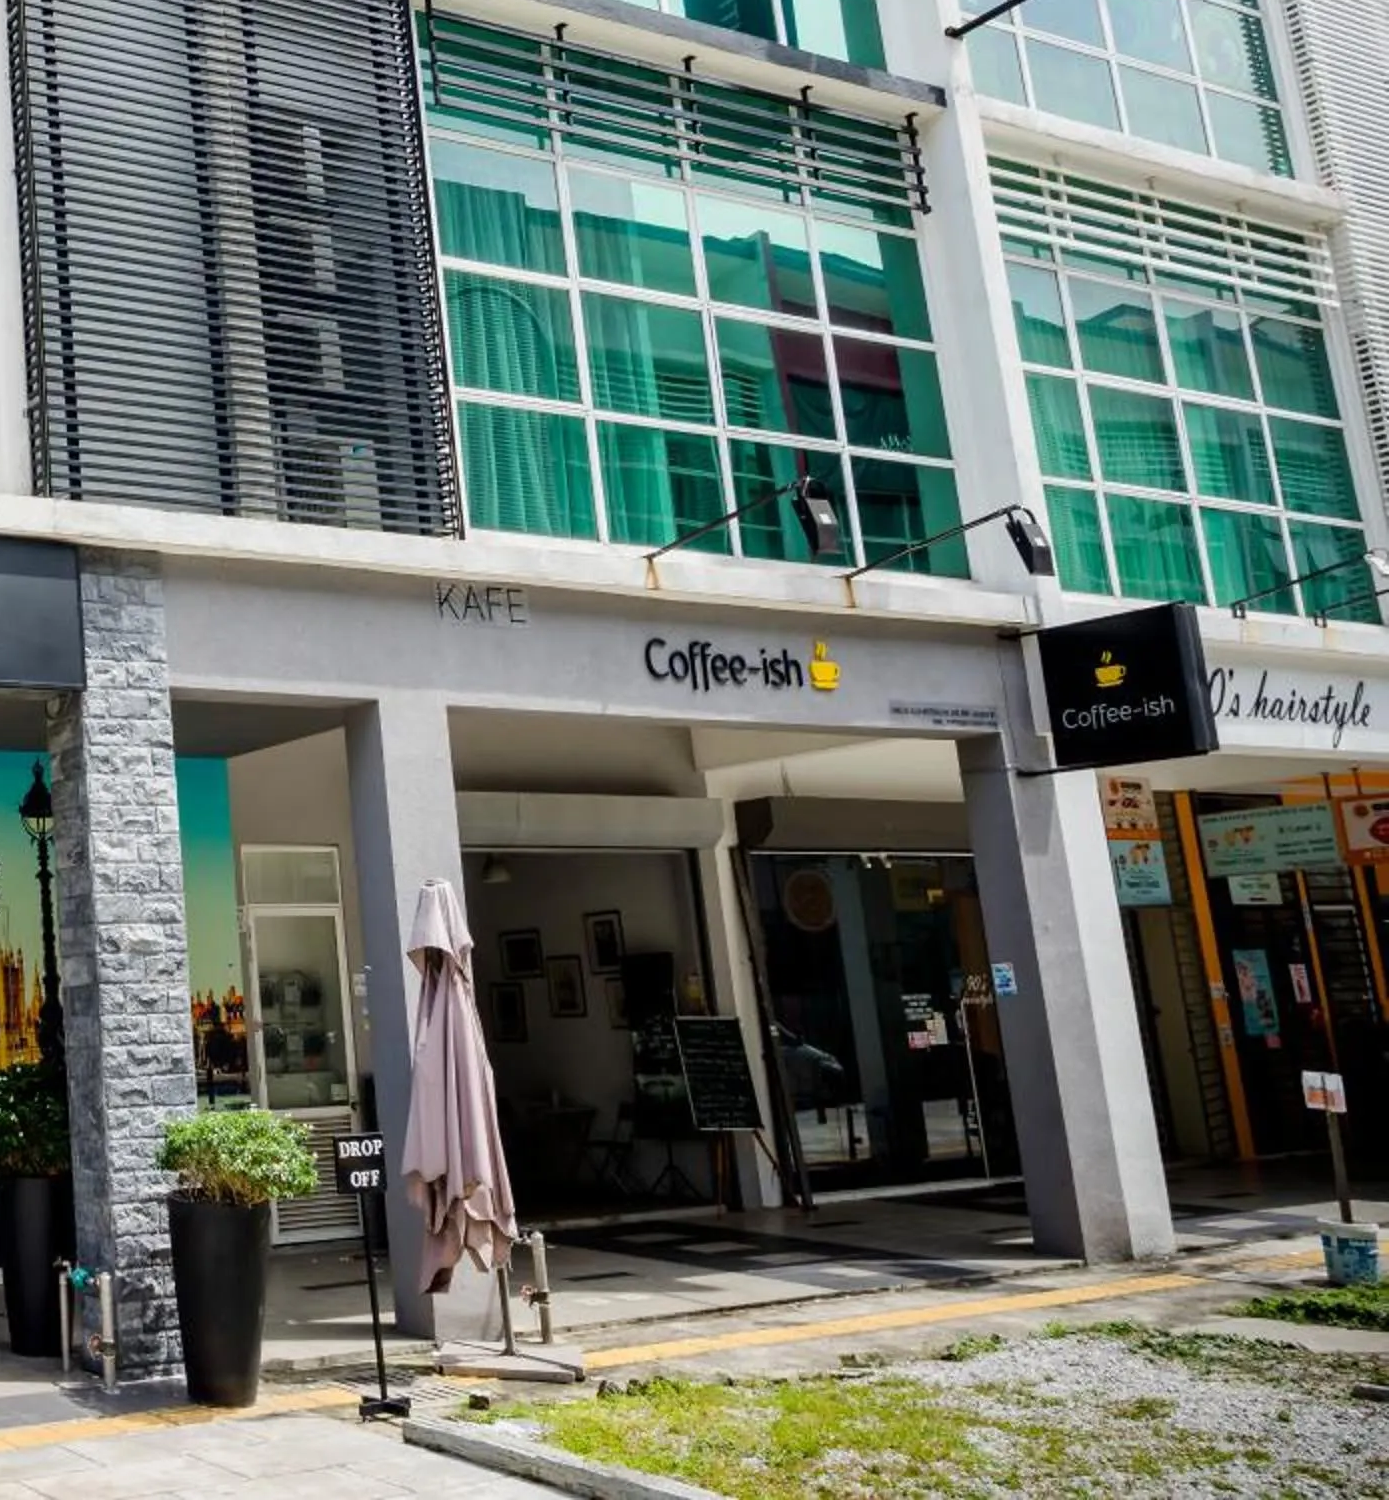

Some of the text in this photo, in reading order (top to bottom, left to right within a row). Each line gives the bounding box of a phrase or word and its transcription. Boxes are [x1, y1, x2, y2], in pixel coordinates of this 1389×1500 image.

[435, 582, 528, 624] KAFE
[644, 637, 804, 692] Coffee-ish
[1062, 694, 1176, 730] Coffee-ish
[1245, 669, 1372, 749] hairstyle
[338, 1139, 383, 1159] DROP
[350, 1169, 380, 1188] OFF
